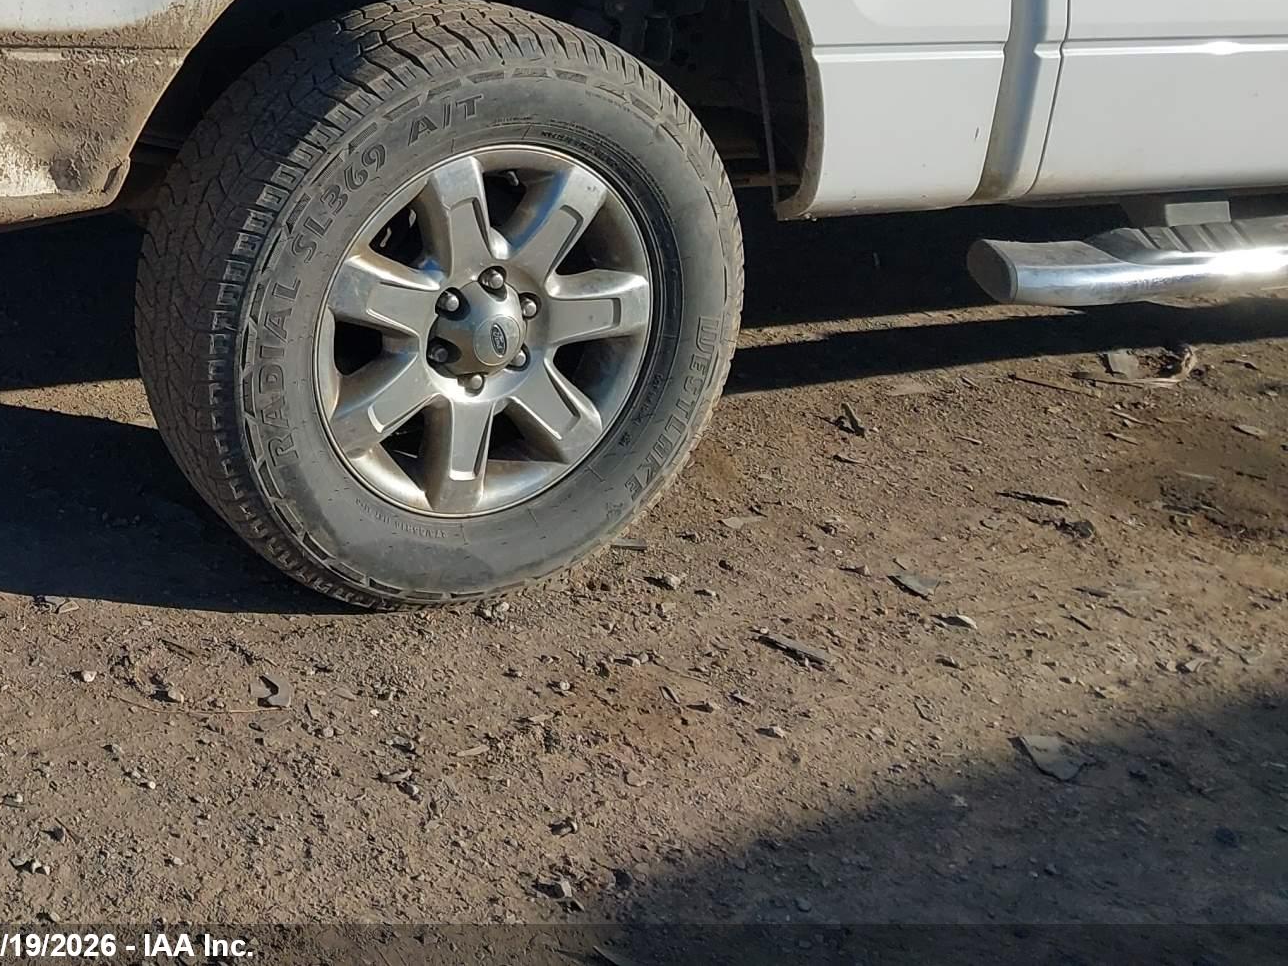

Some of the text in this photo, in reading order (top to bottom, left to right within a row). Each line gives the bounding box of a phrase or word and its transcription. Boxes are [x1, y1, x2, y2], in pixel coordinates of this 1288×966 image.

[259, 94, 483, 468] RADIAL SL369 A/T
[624, 314, 722, 502] WESTLAKE
